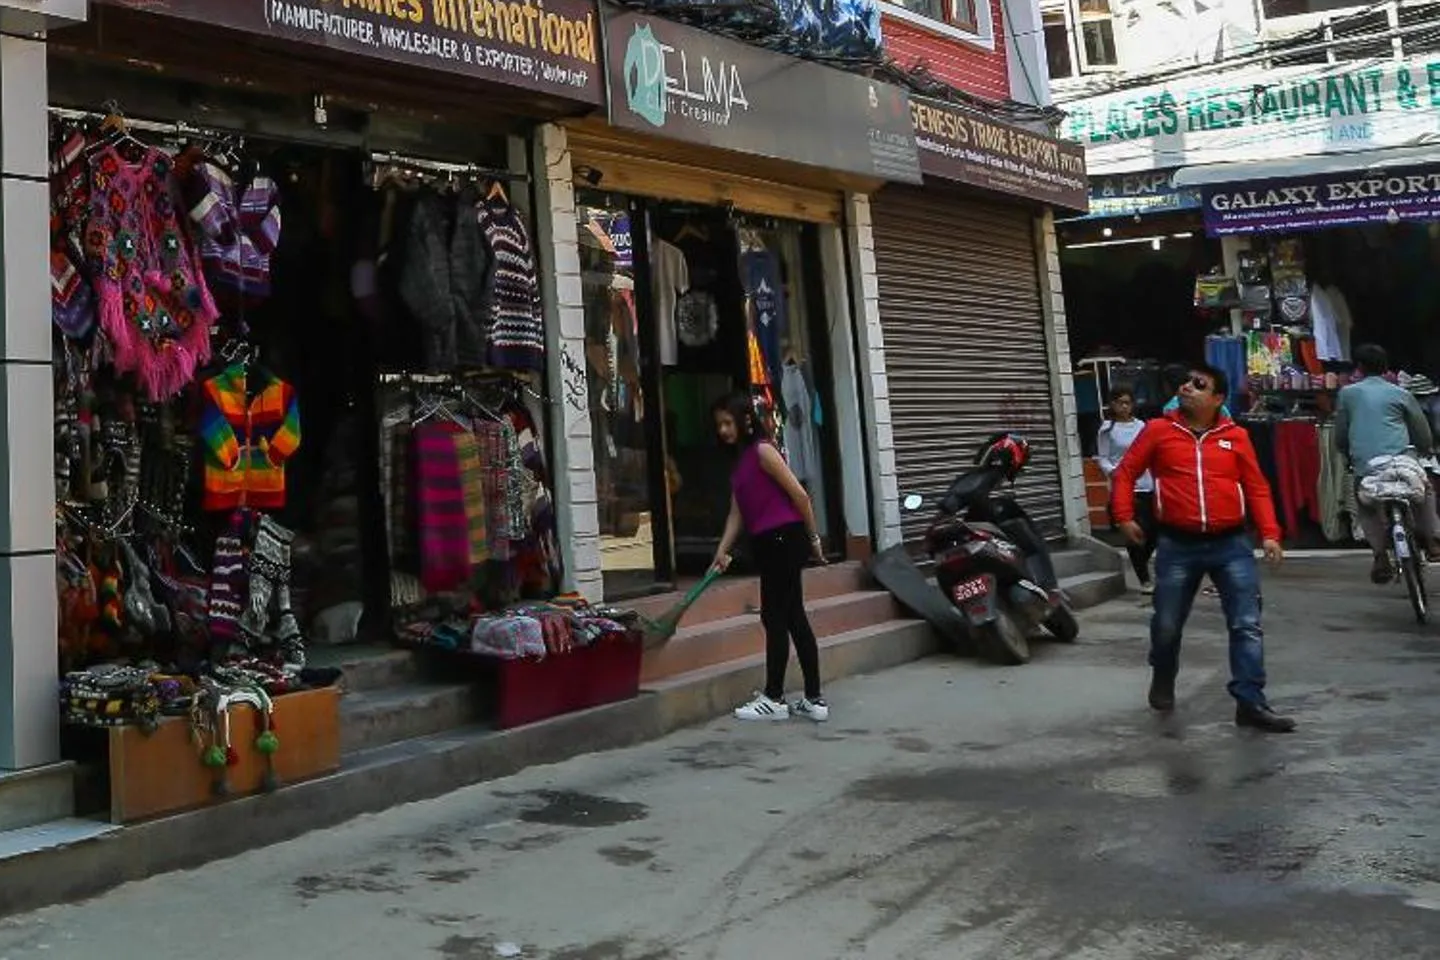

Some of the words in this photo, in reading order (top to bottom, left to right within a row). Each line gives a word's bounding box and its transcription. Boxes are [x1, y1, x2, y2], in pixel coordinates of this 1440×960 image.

[462, 43, 473, 65] &
[1187, 69, 1383, 132] RESTAURANT
[1397, 65, 1421, 109] &
[1210, 186, 1318, 211] GALAXY
